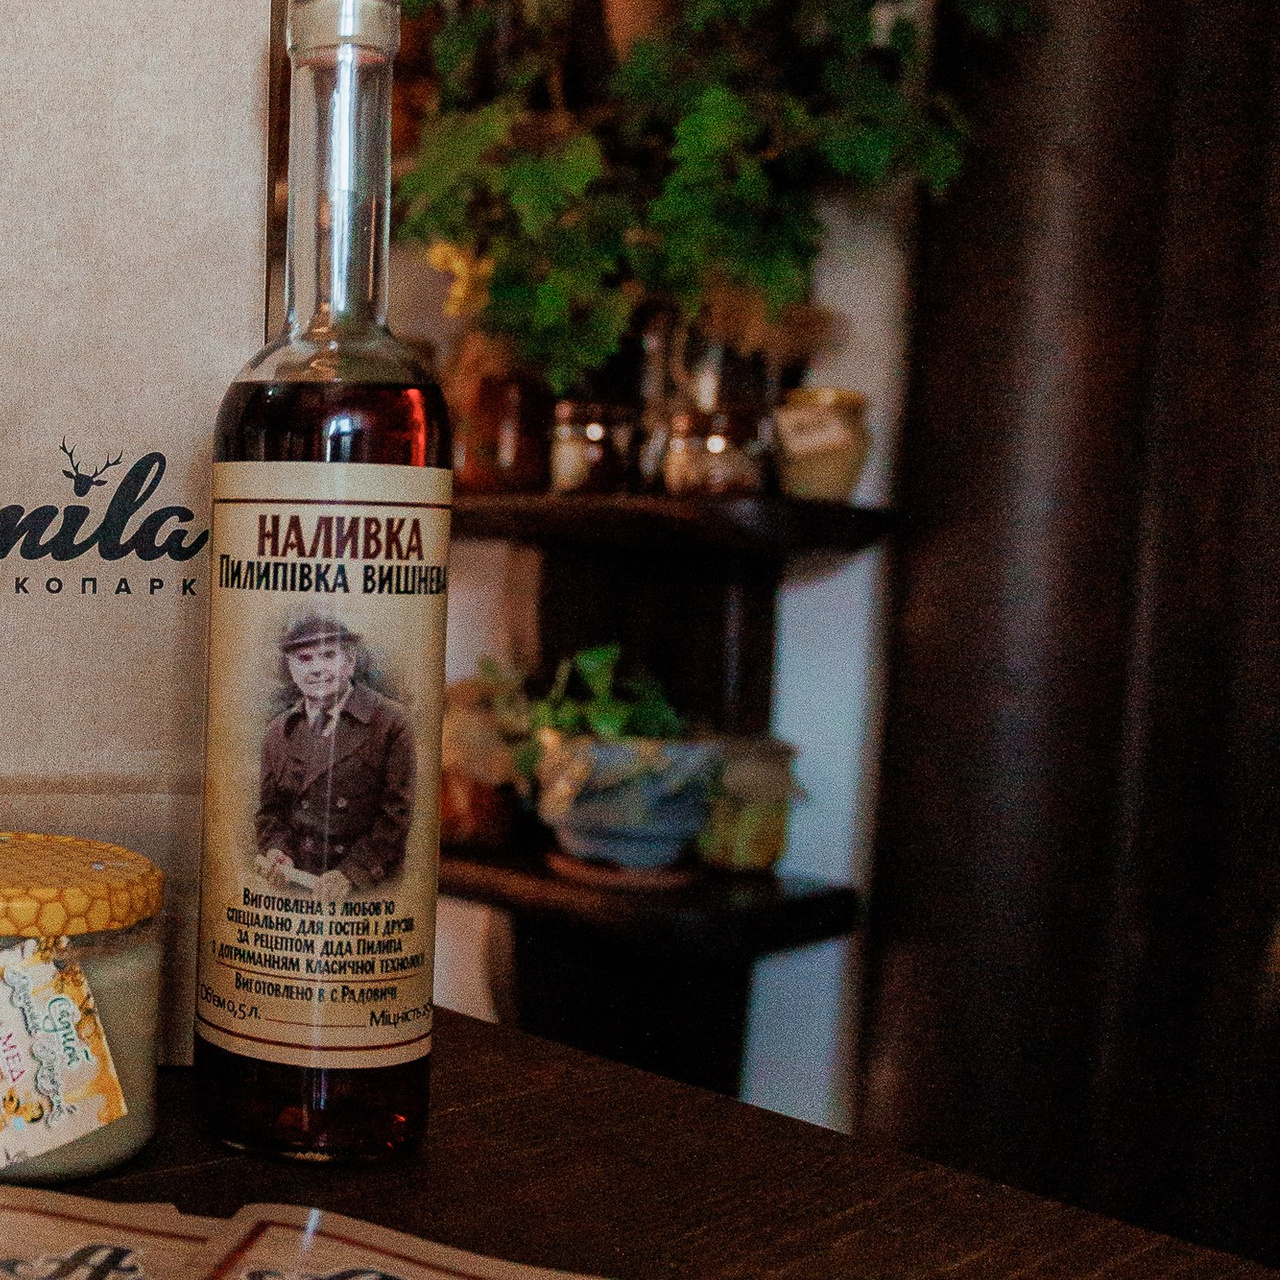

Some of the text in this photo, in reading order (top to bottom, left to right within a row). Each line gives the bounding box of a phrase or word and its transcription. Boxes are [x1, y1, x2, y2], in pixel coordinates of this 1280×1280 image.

[257, 514, 424, 561] НАЛИВКА
[237, 928, 250, 945] ЗА
[253, 932, 315, 955] РЕЦЕПТОМ
[320, 940, 353, 958] ДІДА
[296, 920, 324, 936] ДЛЯ
[329, 919, 370, 936] ГОСТЕЙ
[218, 943, 301, 972] ДОТРИМАННЯМ
[305, 958, 375, 975] КЛАСИЧНОЇ
